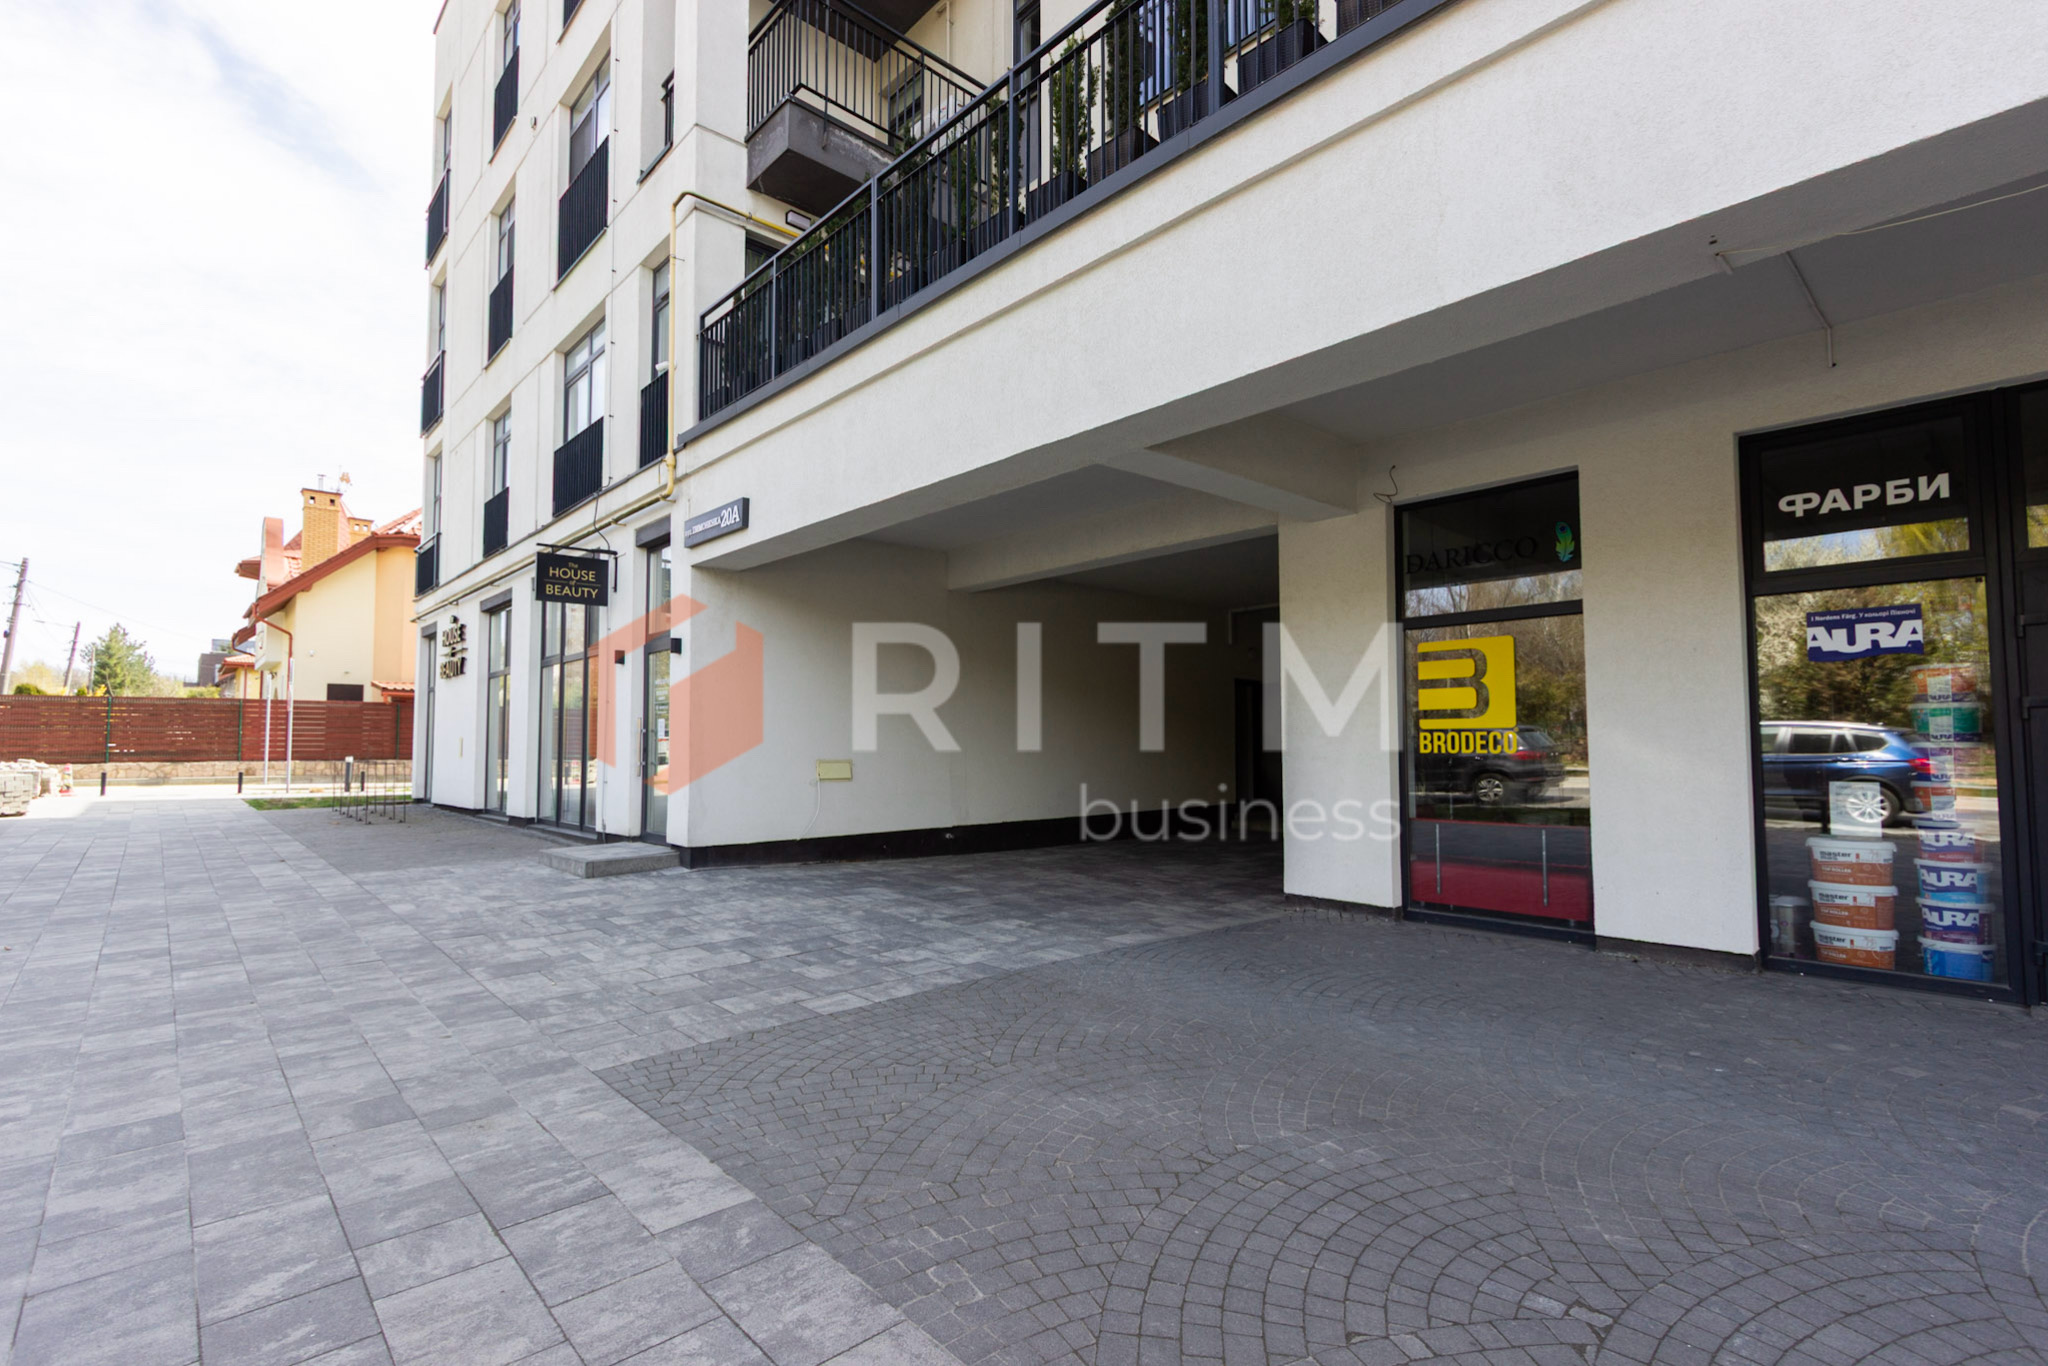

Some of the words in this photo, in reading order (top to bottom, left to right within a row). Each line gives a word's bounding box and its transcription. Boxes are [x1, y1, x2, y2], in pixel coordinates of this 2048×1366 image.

[1778, 472, 1950, 518] ФАРБИ
[1407, 536, 1538, 574] DARICCO
[549, 566, 597, 582] HOUSE
[545, 583, 599, 599] BEAUTY
[1807, 619, 1924, 654] AURA
[1419, 731, 1518, 754] BRODECO
[1920, 868, 1977, 887] AURA
[1922, 907, 1979, 927] AURA
